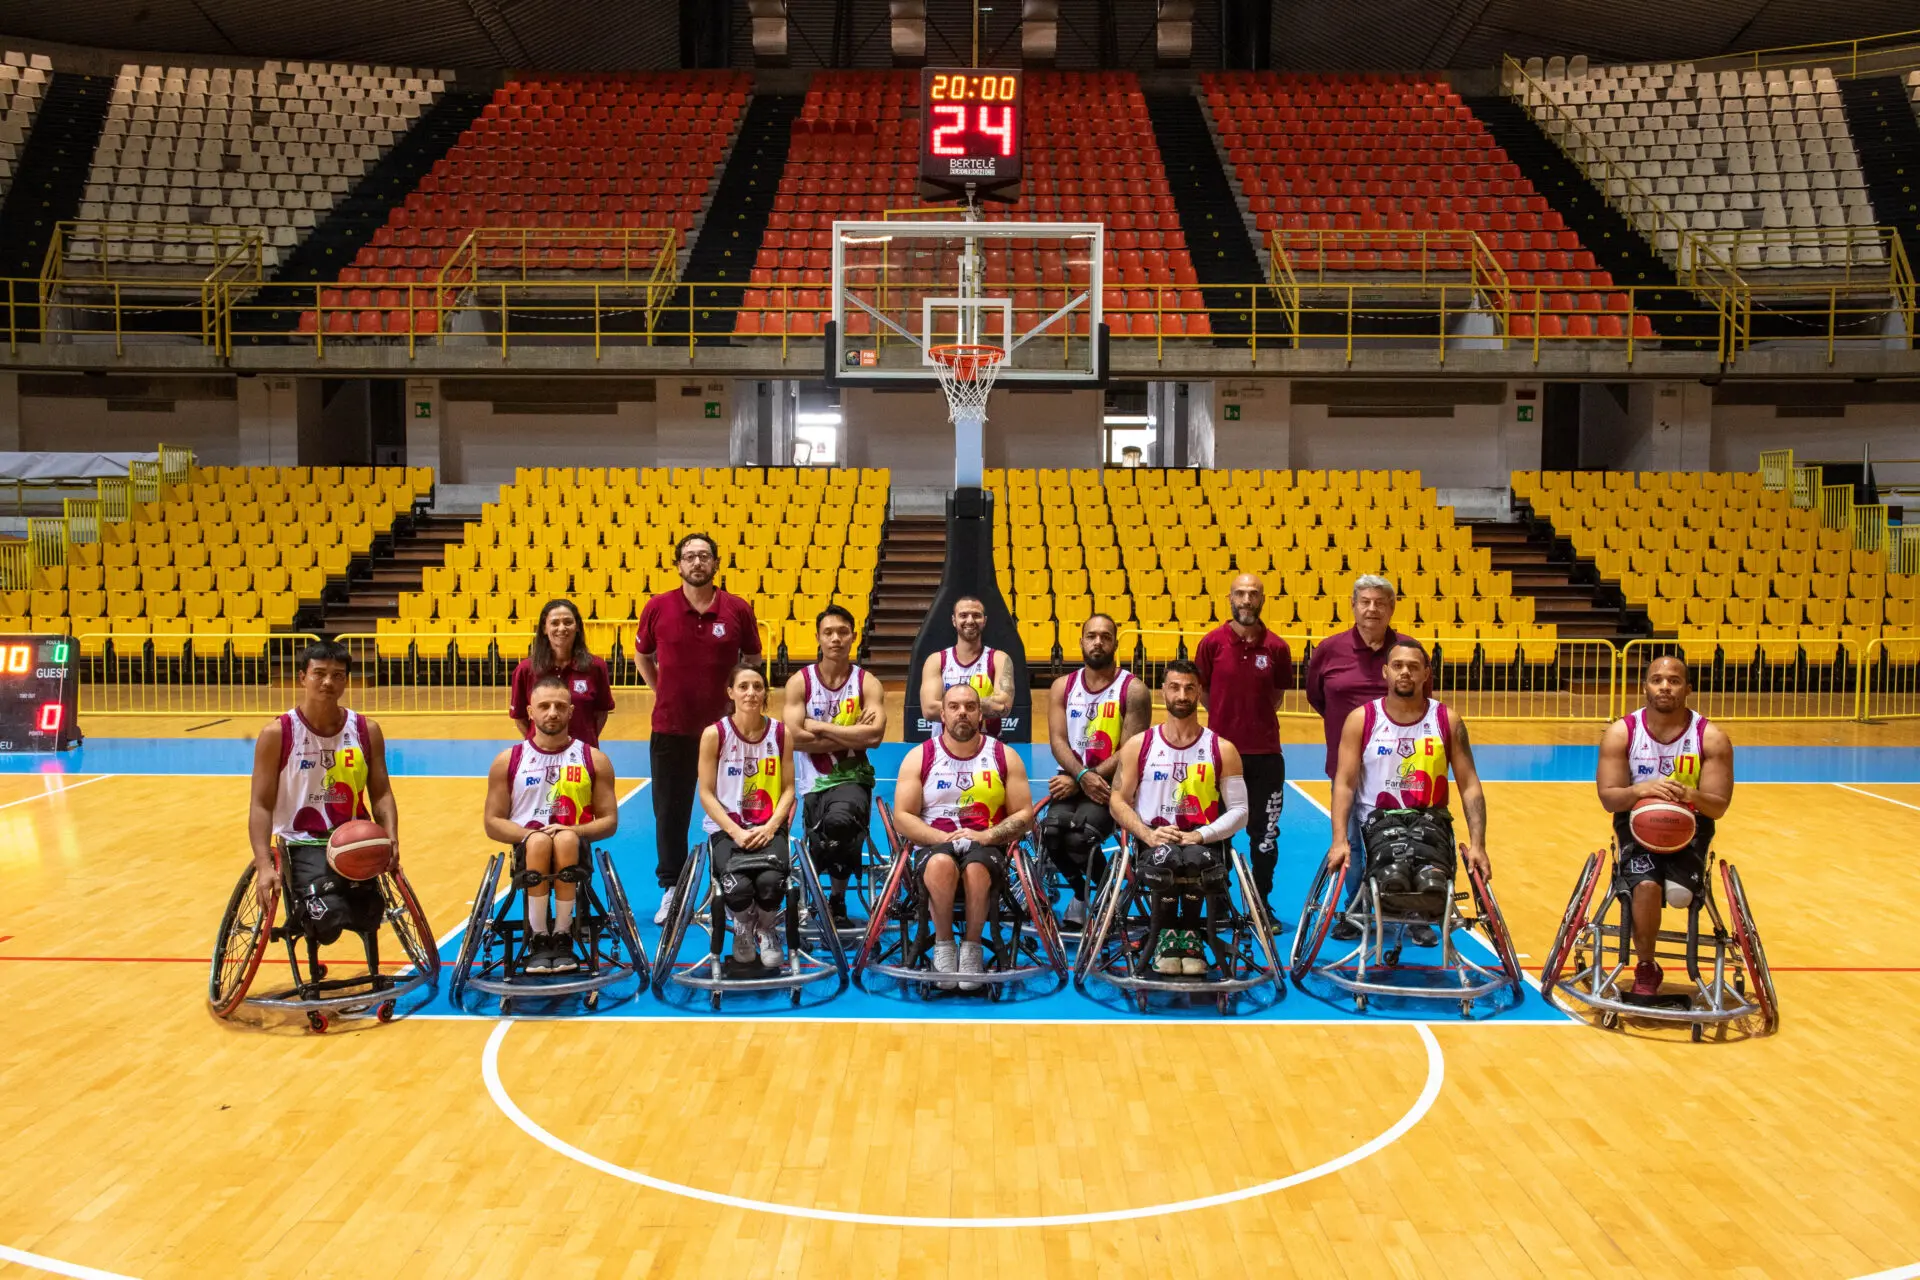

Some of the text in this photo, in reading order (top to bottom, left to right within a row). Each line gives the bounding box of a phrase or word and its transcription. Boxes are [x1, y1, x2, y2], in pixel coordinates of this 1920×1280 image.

[932, 75, 1015, 99] 20:00
[933, 106, 1011, 155] 24
[54, 644, 69, 663] 0
[36, 668, 69, 679] GUEST
[41, 704, 62, 730] 0
[1102, 702, 1116, 718] 10
[1424, 738, 1434, 756] 6
[344, 749, 354, 767] 2
[1679, 755, 1694, 774] 17
[566, 765, 582, 783] 88
[1197, 763, 1206, 782] 4
